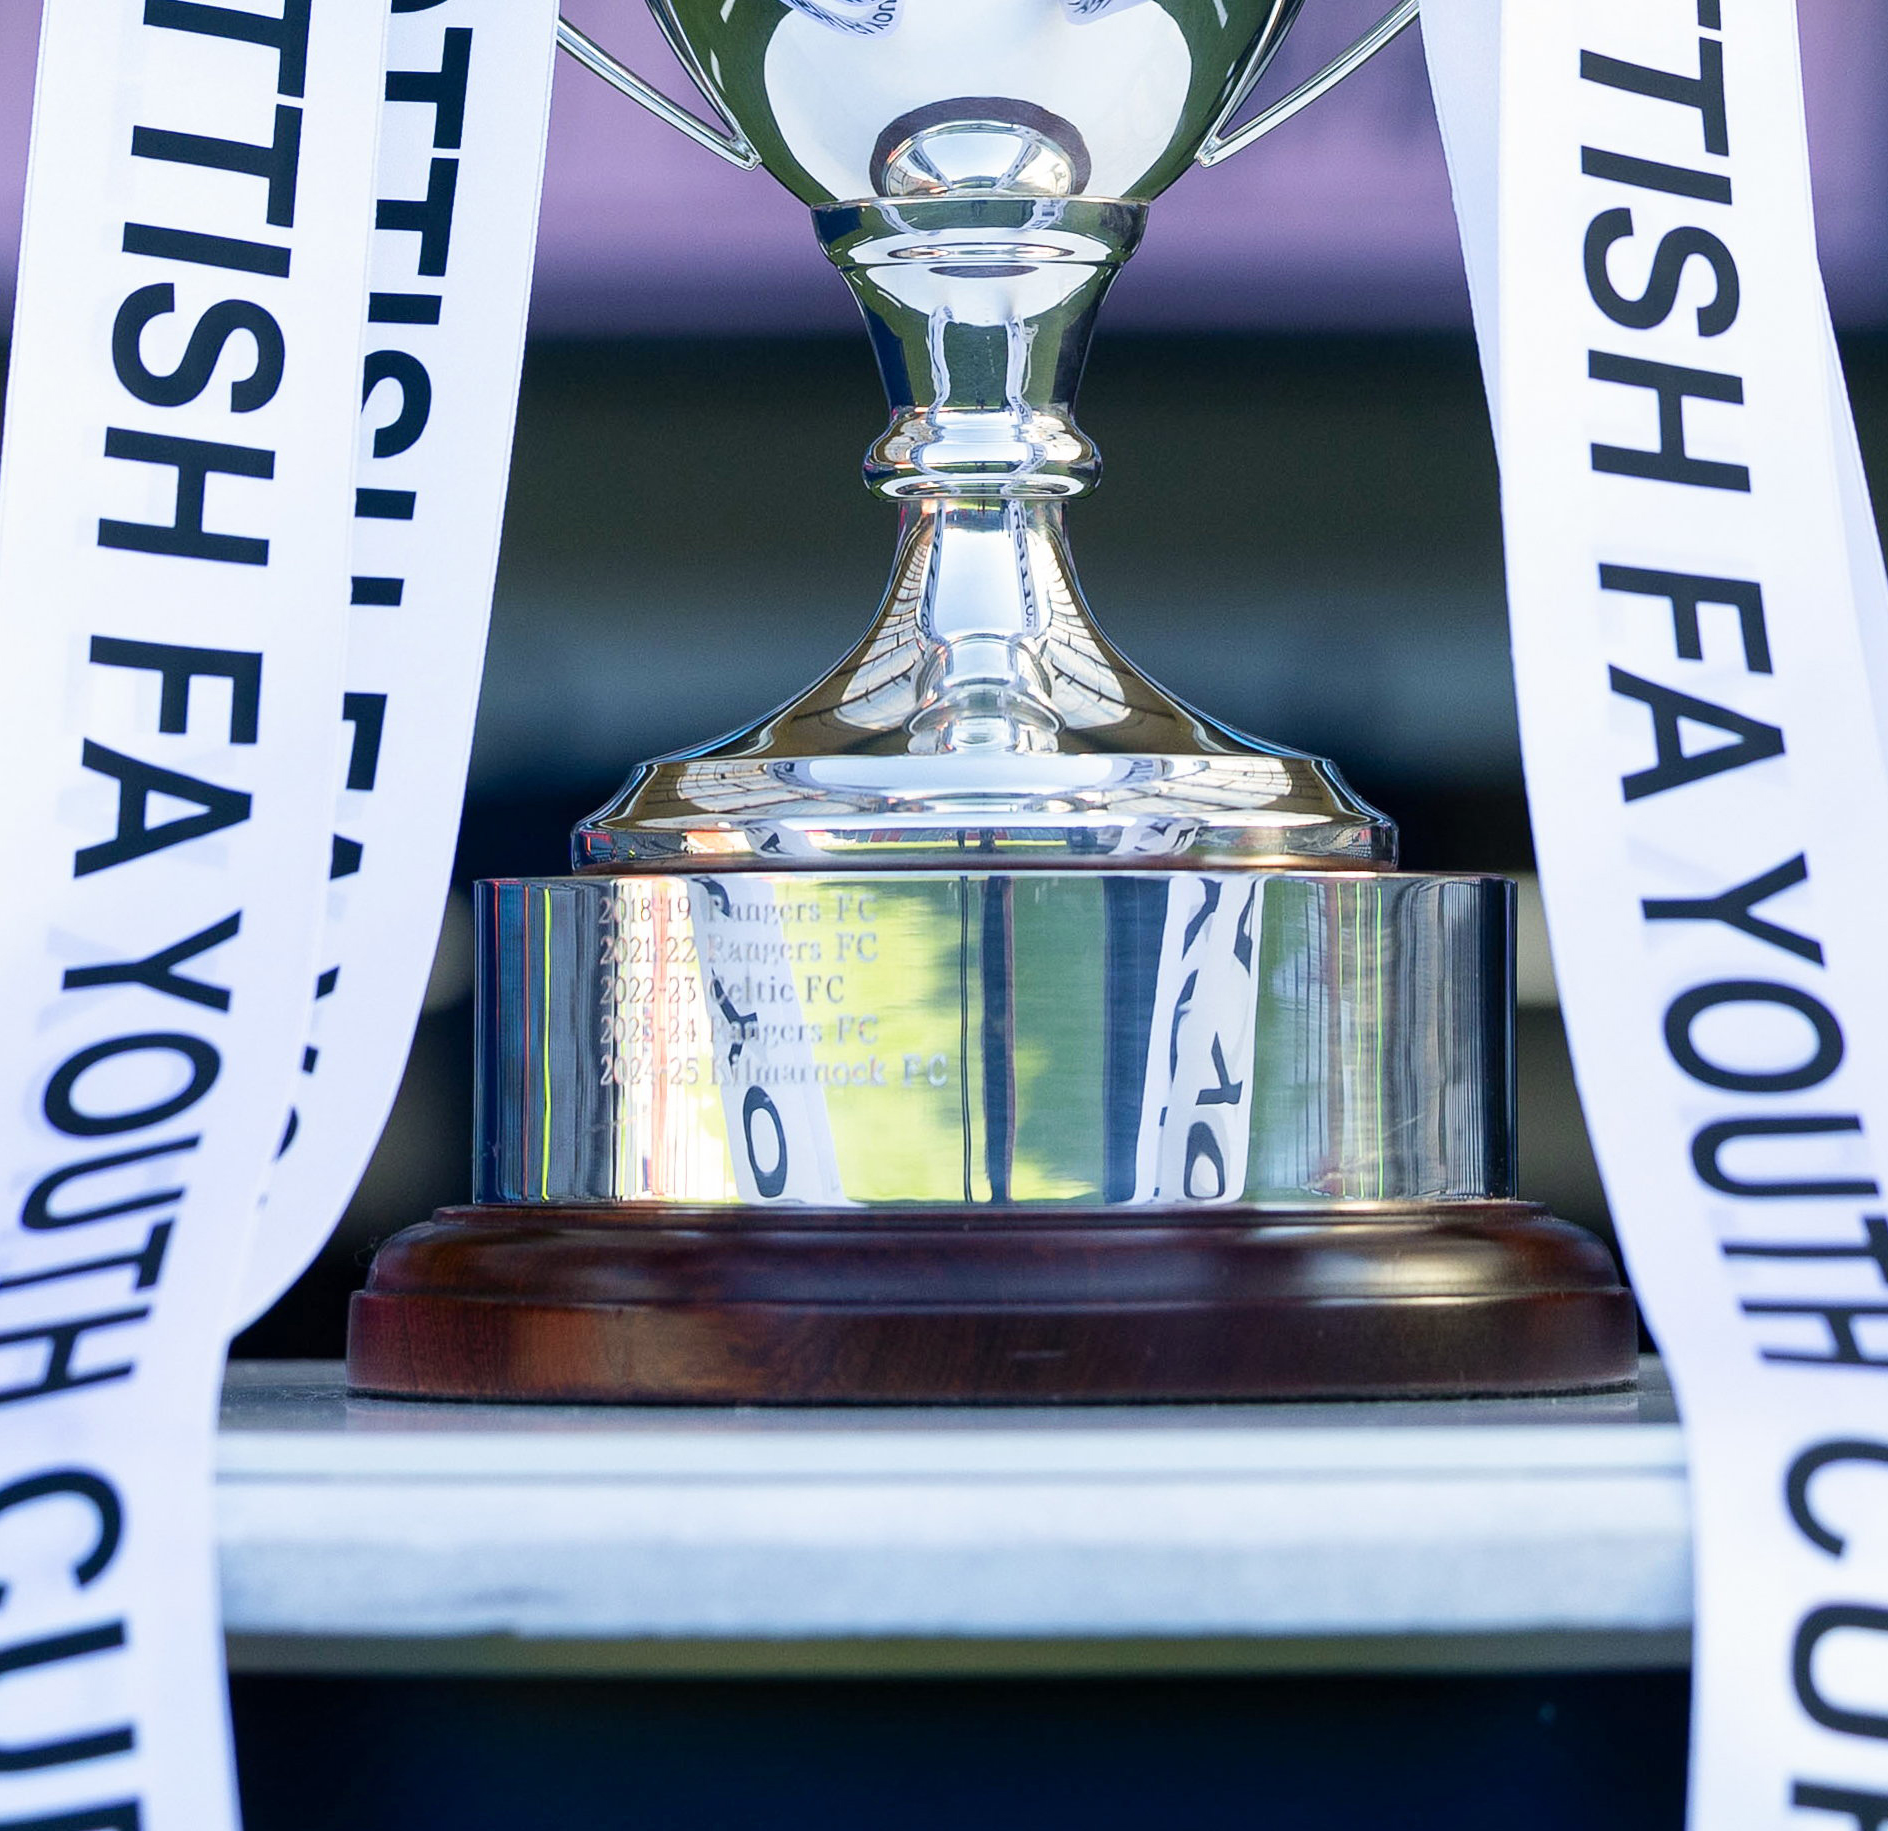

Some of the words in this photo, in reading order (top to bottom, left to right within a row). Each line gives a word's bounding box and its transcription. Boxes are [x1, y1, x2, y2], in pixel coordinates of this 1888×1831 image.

[1598, 562, 1786, 803] FA
[73, 635, 263, 879] FA
[600, 896, 692, 924] 2018-19
[704, 896, 821, 926] Rangers
[835, 894, 879, 923] FC
[600, 936, 697, 965] 2021-22
[707, 934, 822, 965] Rangers
[835, 932, 879, 963] FC
[600, 975, 697, 1005] 2022-23
[709, 973, 794, 1004] Celtic
[805, 974, 846, 1004] FC
[709, 1015, 823, 1049] Rangers
[835, 1014, 879, 1044] FC
[711, 1053, 888, 1087] Kilmarnock
[901, 1052, 949, 1088] FC
